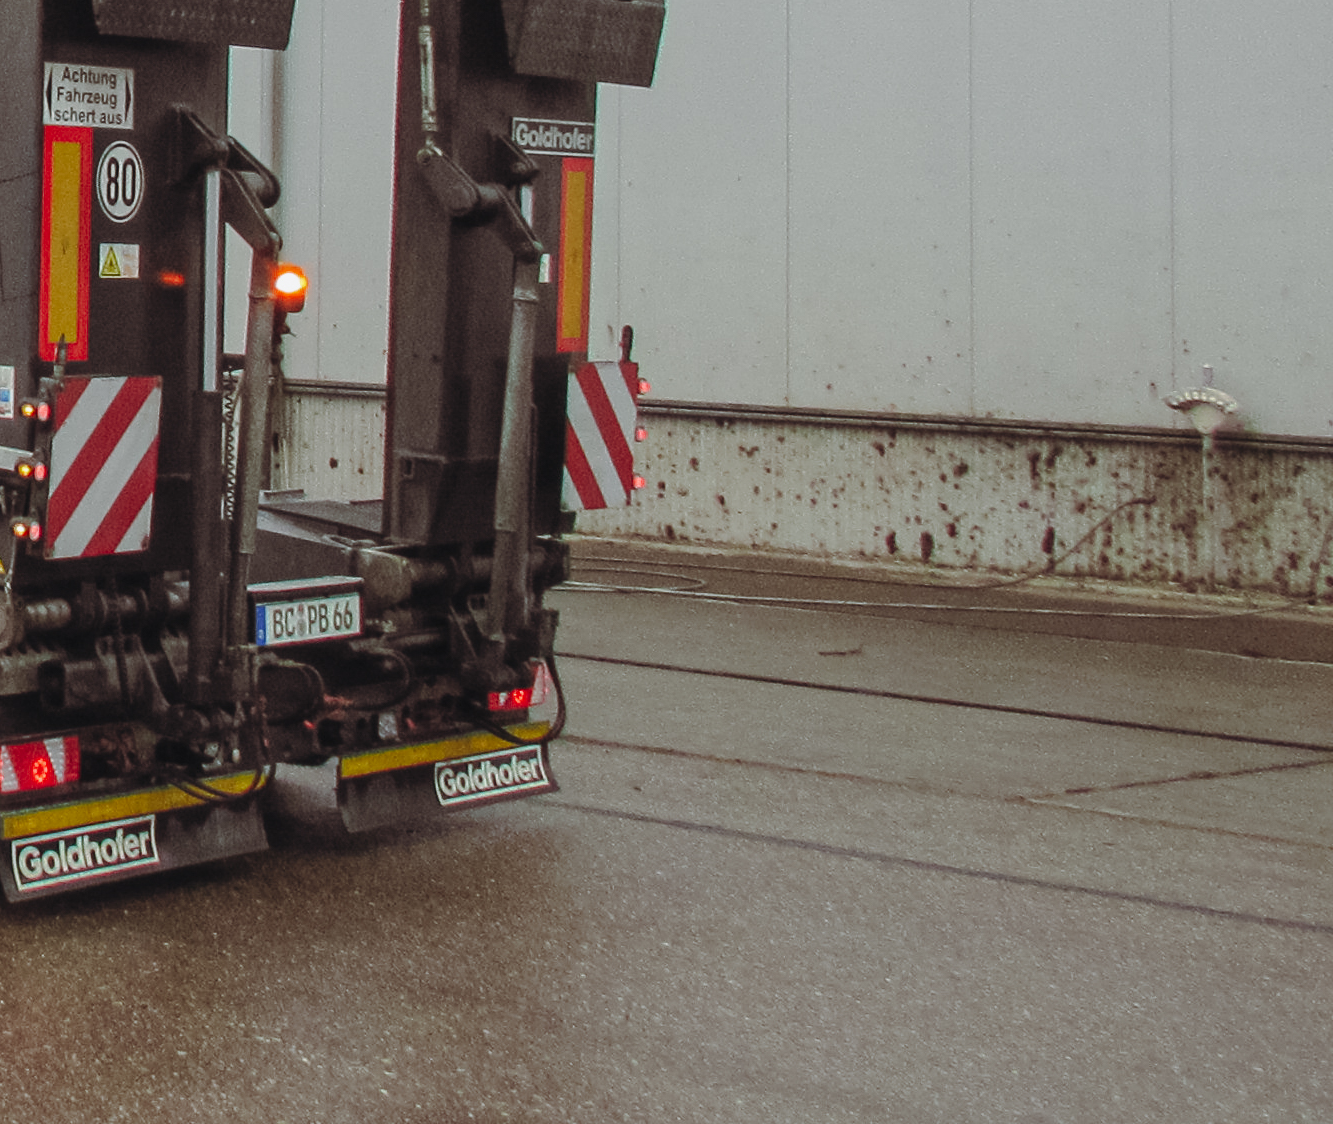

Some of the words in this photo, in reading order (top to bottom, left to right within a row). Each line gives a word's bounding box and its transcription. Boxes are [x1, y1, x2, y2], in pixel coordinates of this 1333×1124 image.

[62, 66, 117, 89] Achtung
[56, 87, 118, 109] Fahrzeug
[54, 107, 96, 123] schert
[99, 112, 122, 125] aus
[515, 123, 592, 150] Goldhofer
[106, 156, 136, 207] 80
[273, 608, 295, 638] BC
[308, 604, 329, 634] PB
[334, 600, 353, 631] 66
[439, 755, 539, 796] Goldhofer
[18, 827, 150, 880] Goldhofer
